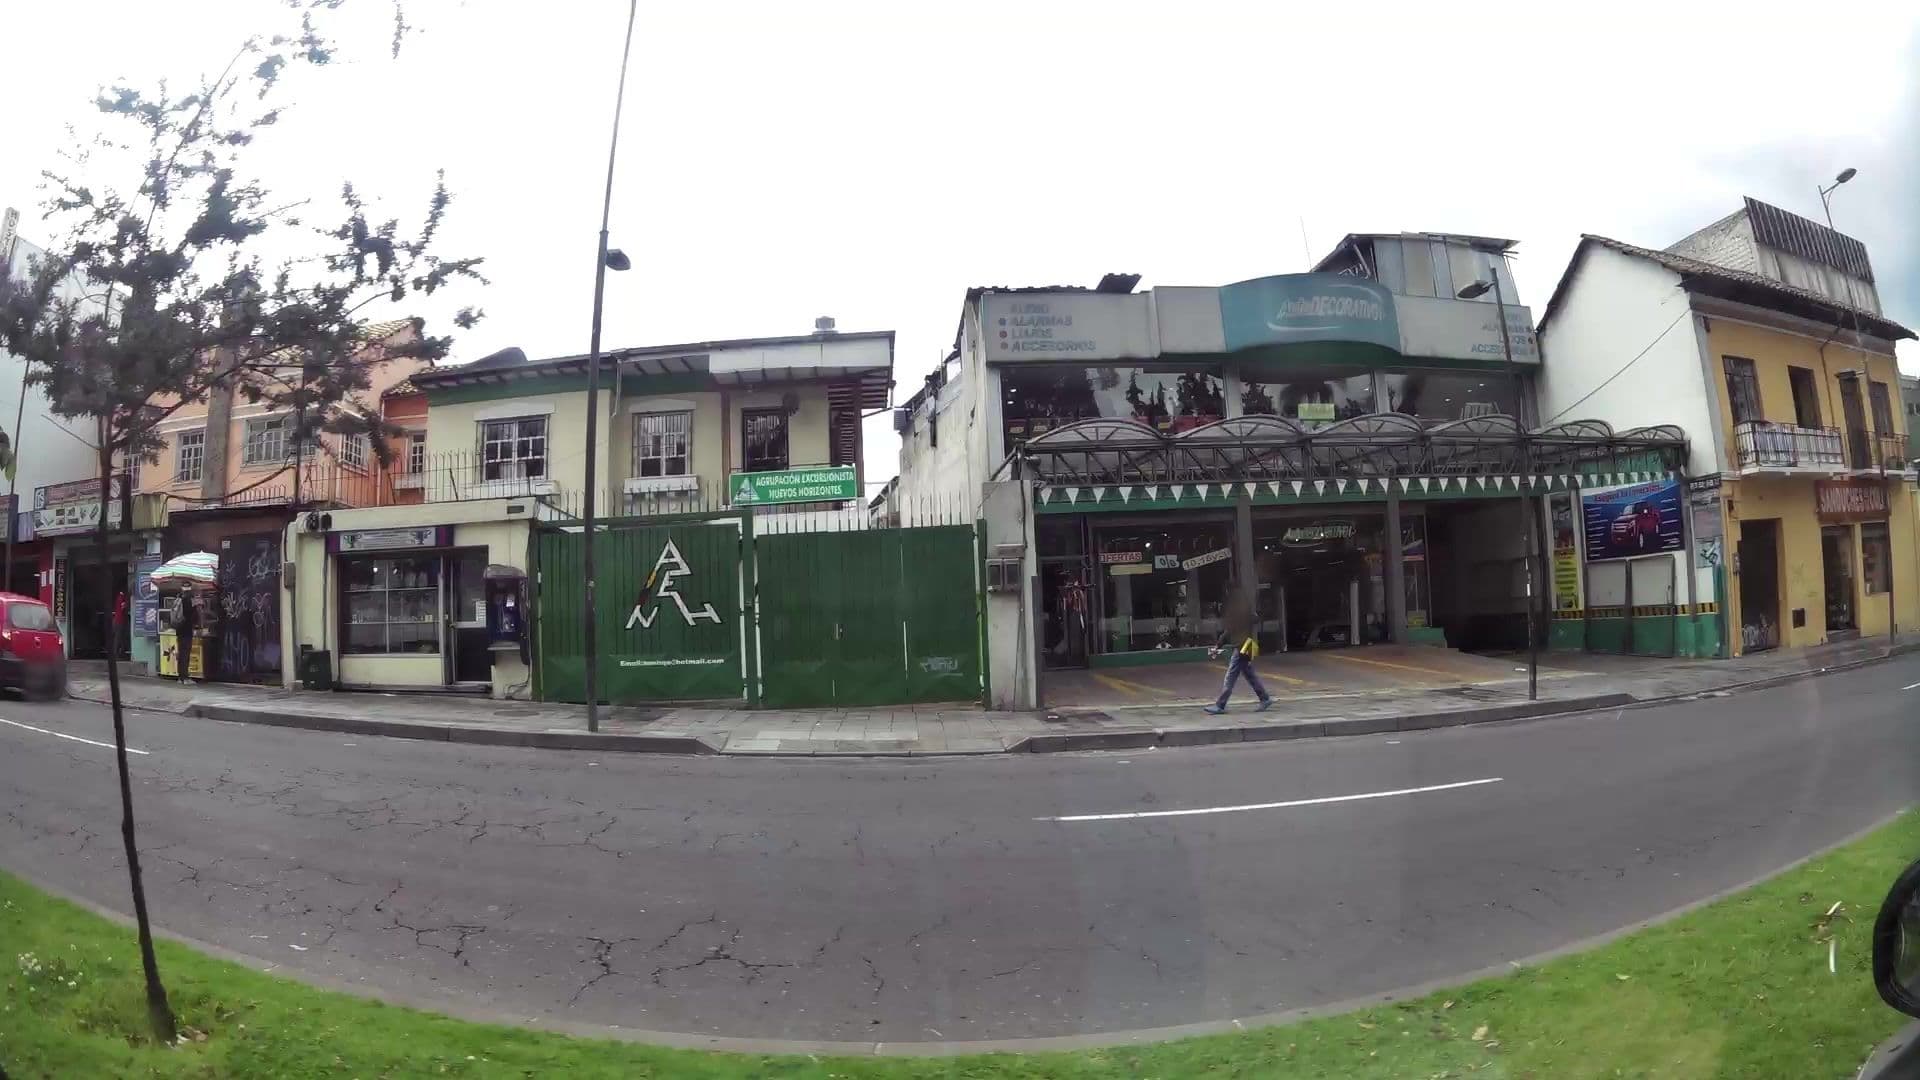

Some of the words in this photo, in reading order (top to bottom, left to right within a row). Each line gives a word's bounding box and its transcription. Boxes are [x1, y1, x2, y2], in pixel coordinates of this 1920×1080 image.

[1011, 340, 1096, 352] ACCESORIOS
[769, 487, 797, 499] NUEVOS
[798, 485, 843, 497] HORIZONTES
